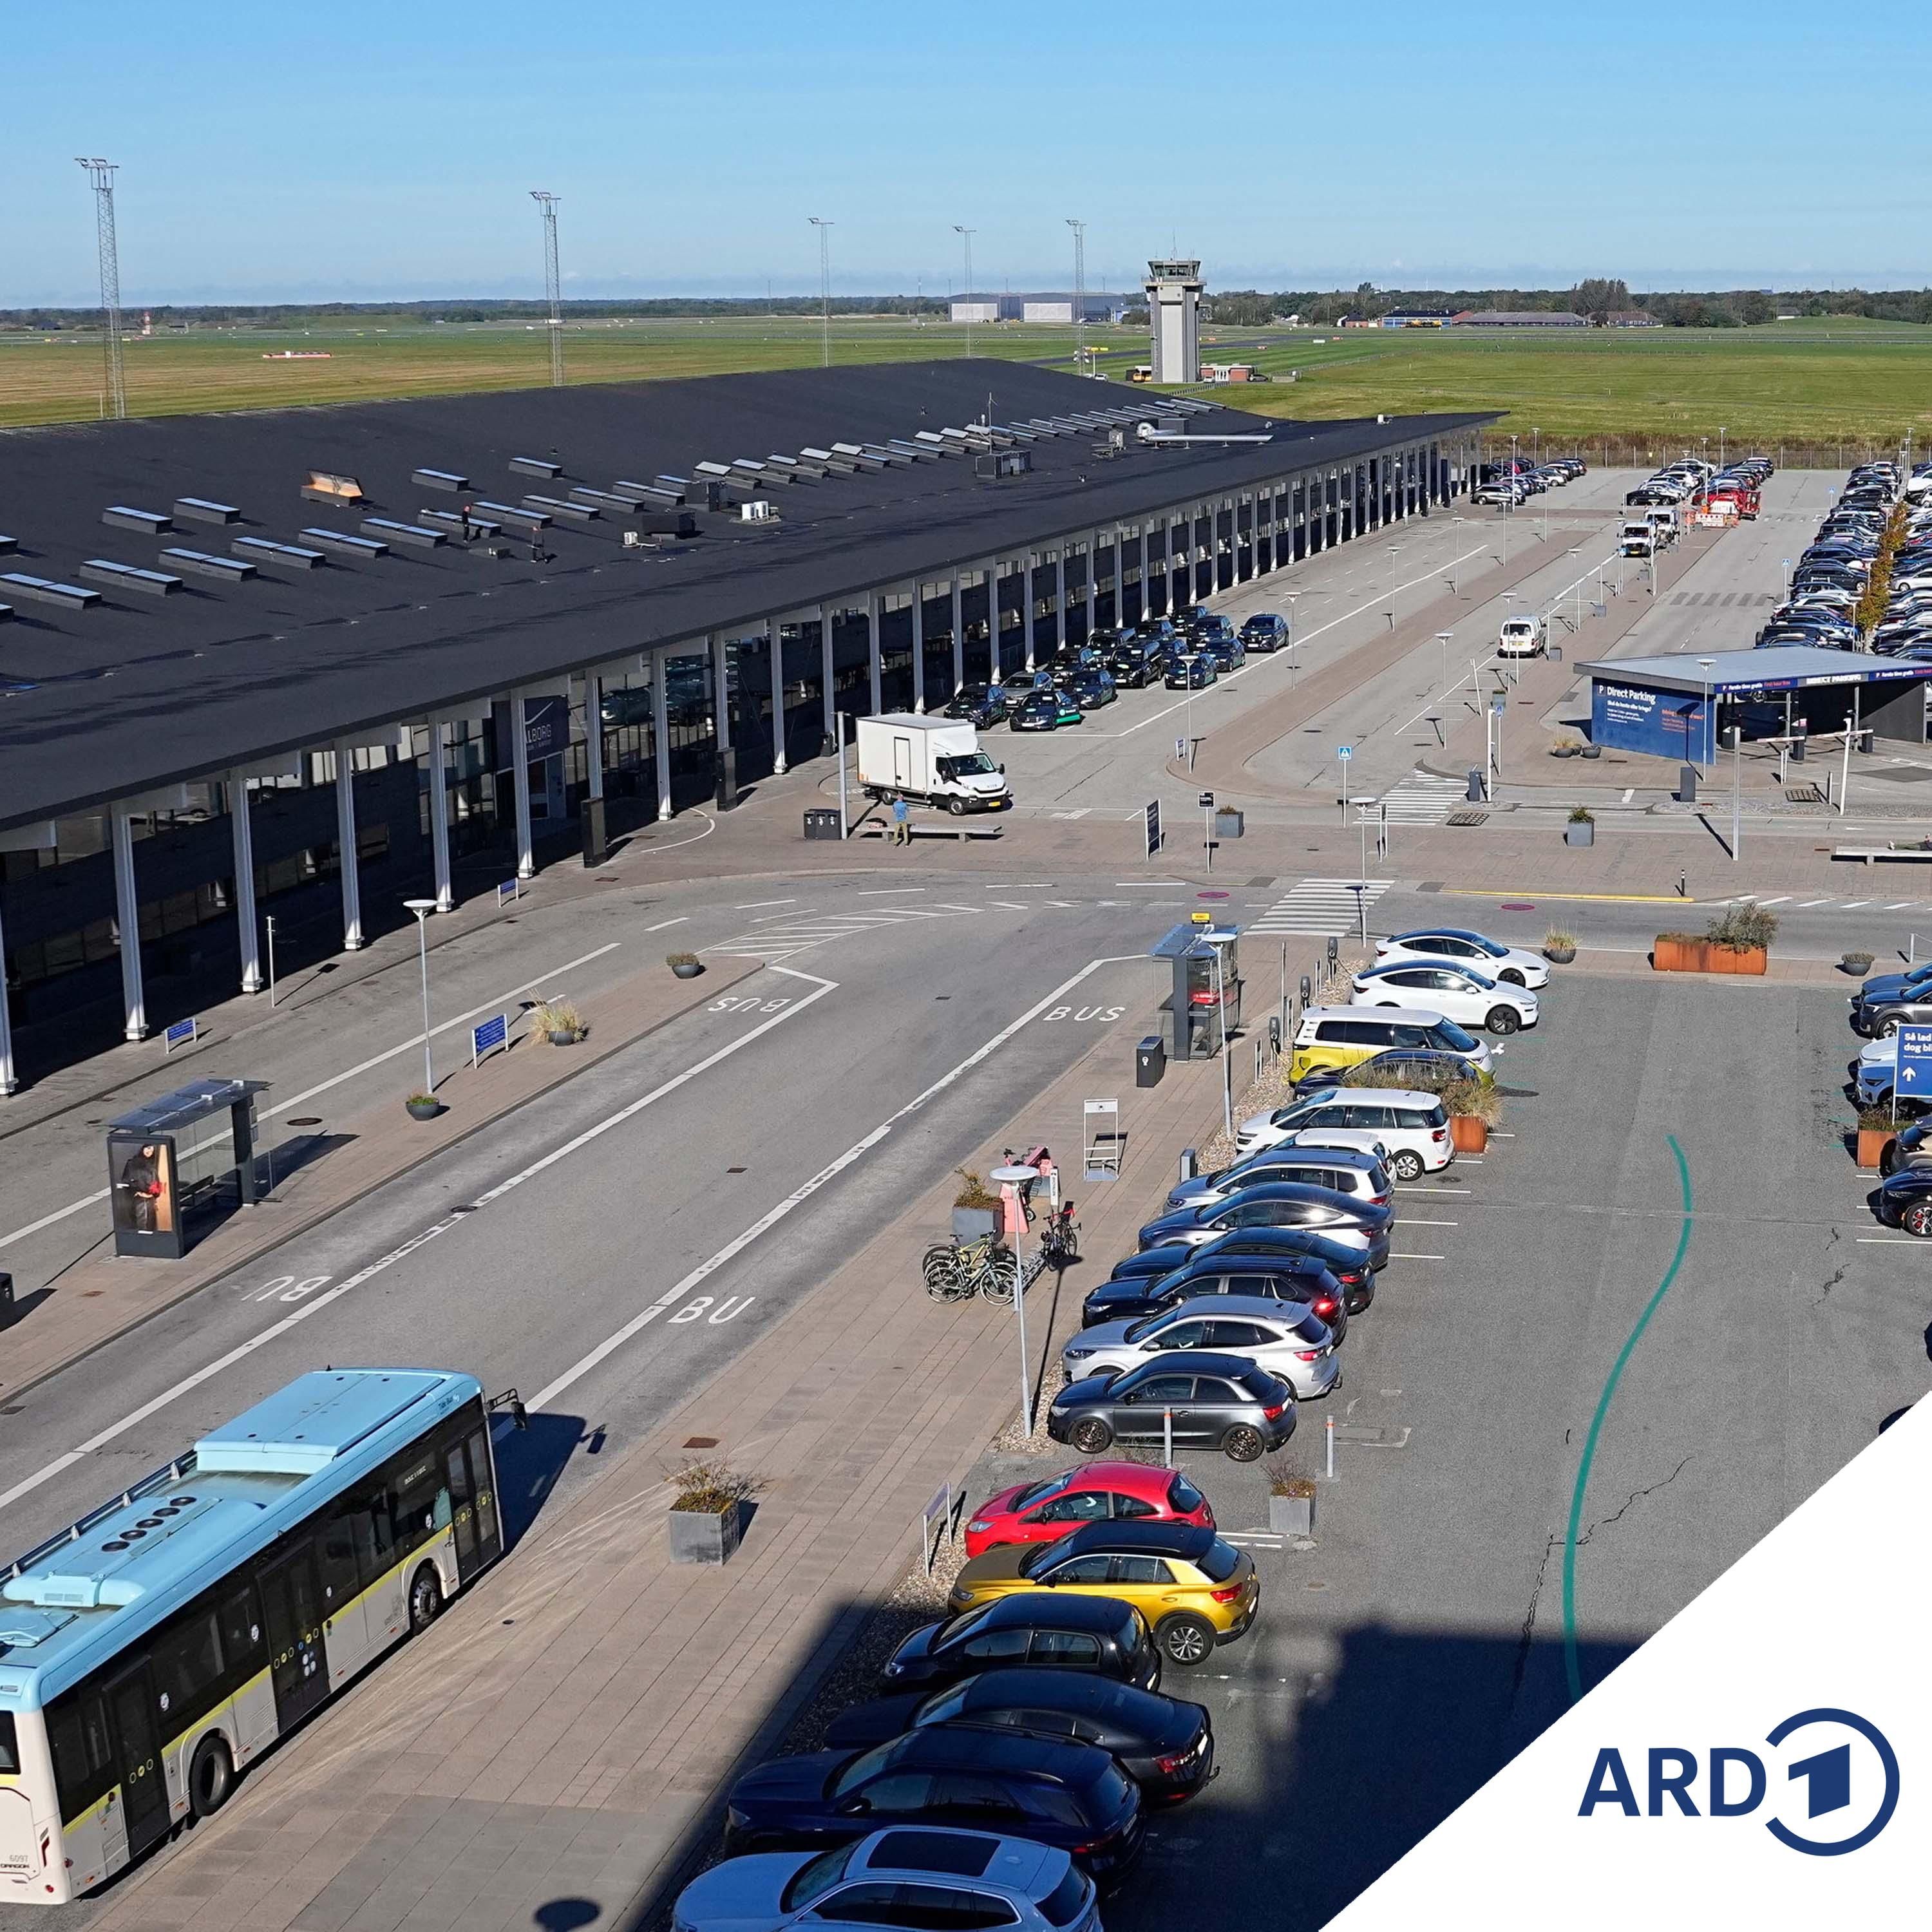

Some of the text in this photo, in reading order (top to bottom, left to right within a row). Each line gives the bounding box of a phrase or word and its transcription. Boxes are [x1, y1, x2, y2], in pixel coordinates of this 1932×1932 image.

[1607, 686, 1628, 698] Direct
[1629, 689, 1656, 705] Parking
[708, 997, 791, 1012] BUS
[1043, 1006, 1126, 1021] BUS
[1904, 1032, 1916, 1041] Så
[1904, 1043, 1922, 1054] dog
